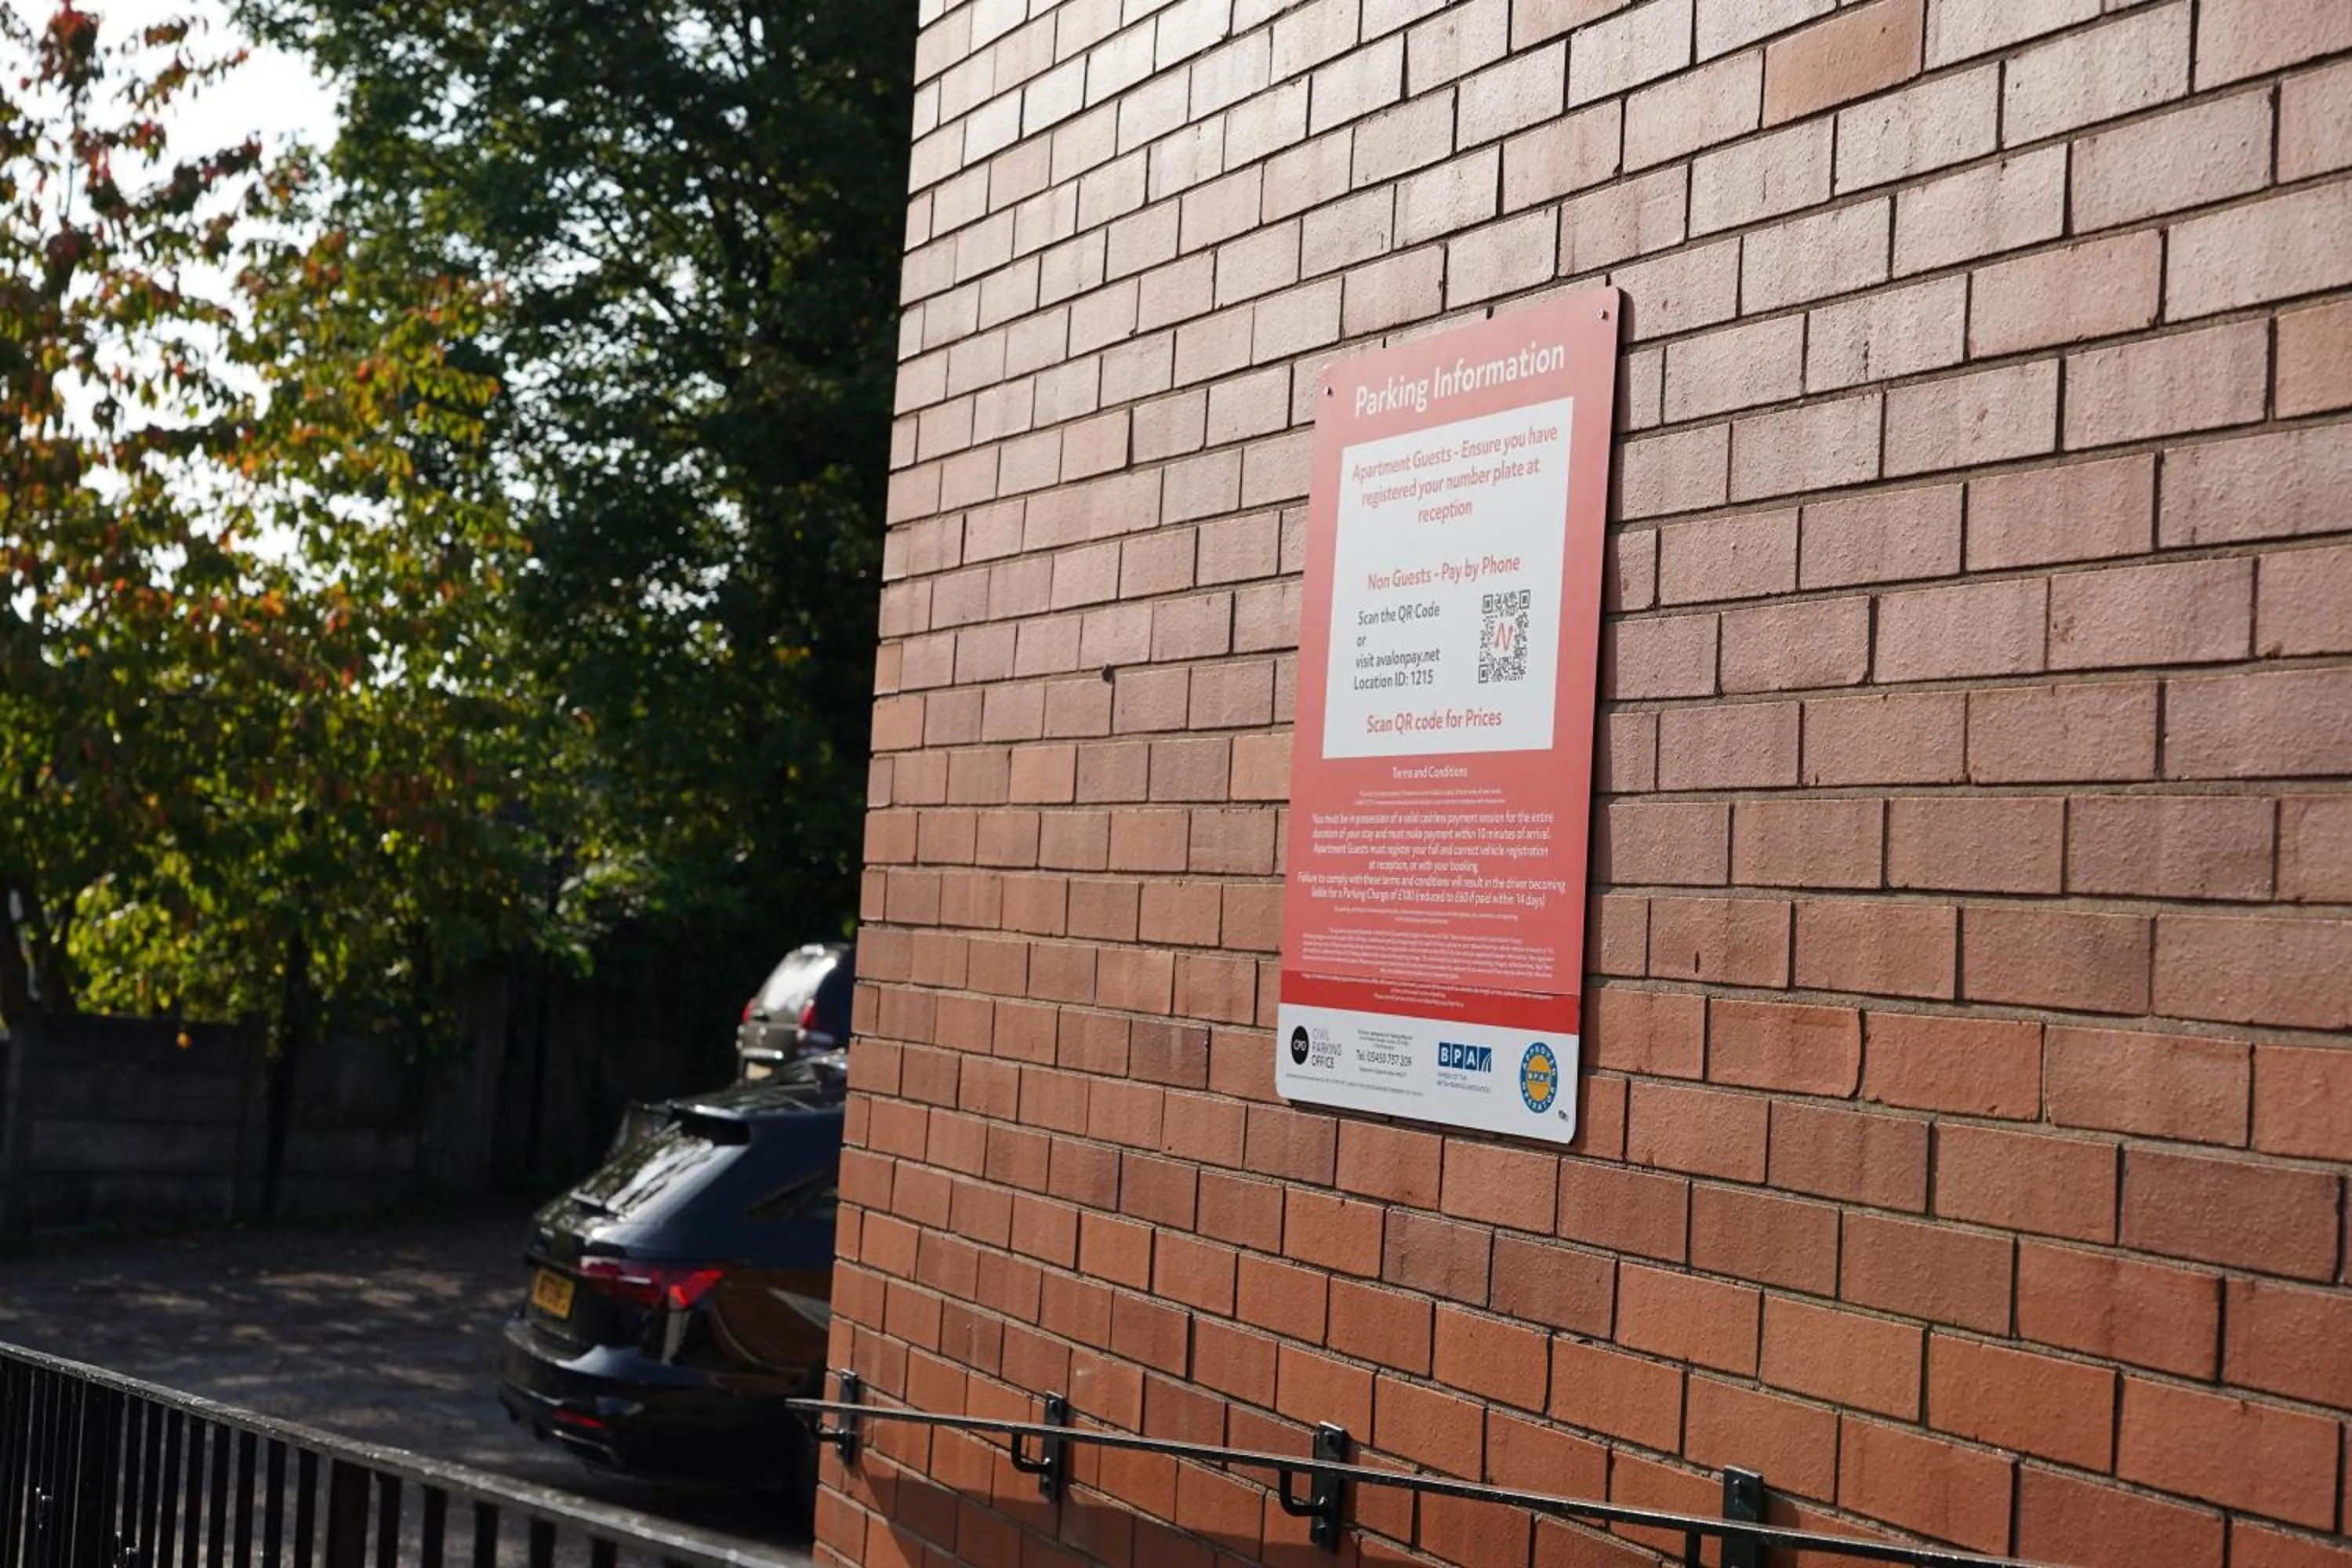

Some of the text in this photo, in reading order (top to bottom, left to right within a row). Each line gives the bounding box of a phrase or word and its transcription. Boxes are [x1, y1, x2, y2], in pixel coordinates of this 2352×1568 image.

[1355, 341, 1564, 417] Parking Information
[1352, 455, 1411, 485] Apartment
[1413, 447, 1451, 470] Guests
[1461, 440, 1502, 459] Ensure
[1504, 433, 1526, 456] you
[1528, 426, 1558, 446] have
[1362, 458, 1540, 509] registered your number plate at
[1417, 499, 1472, 524] reception
[1368, 574, 1390, 590] Non
[1392, 568, 1432, 587] Guests
[1442, 562, 1462, 584] Pay
[1465, 558, 1479, 582] by
[1482, 555, 1520, 575] Phone
[1358, 601, 1440, 626] Scan the QR Code
[1356, 636, 1366, 648] or
[1356, 649, 1440, 669] visit avalonpay.net
[1354, 670, 1434, 690] Location ID: 1215
[1367, 708, 1502, 735] Scan QR code for Prices
[1414, 766, 1427, 779] and
[1428, 765, 1468, 778] Conditions
[1341, 811, 1348, 824] be
[1447, 814, 1477, 827] payment
[1506, 810, 1516, 824] for
[1518, 811, 1530, 824] the
[1531, 811, 1555, 824] entire
[1375, 827, 1386, 839] and
[1423, 829, 1453, 843] payment
[1454, 827, 1476, 840] within
[1486, 827, 1515, 840] minutes
[1516, 826, 1526, 840] of
[1411, 846, 1427, 859] your
[1428, 842, 1439, 855] full
[1439, 843, 1453, 855] and
[1454, 845, 1479, 856] correct
[1480, 844, 1504, 856] vehicle
[1505, 844, 1548, 859] registration
[1434, 862, 1450, 873] your
[1415, 875, 1449, 887] conditions
[1493, 876, 1504, 888] the
[1505, 876, 1527, 889] driver
[1529, 877, 1566, 895] becoming
[1367, 887, 1389, 902] Charge
[1390, 887, 1398, 901] of
[1446, 891, 1454, 903] to
[1475, 892, 1492, 907] paid
[1493, 892, 1515, 905] within
[1517, 893, 1525, 905] 14
[1294, 1039, 1307, 1051] CPO
[1312, 1041, 1341, 1056] PARKING
[1311, 1054, 1334, 1069] OFFICE
[1439, 1046, 1476, 1066] BPA
